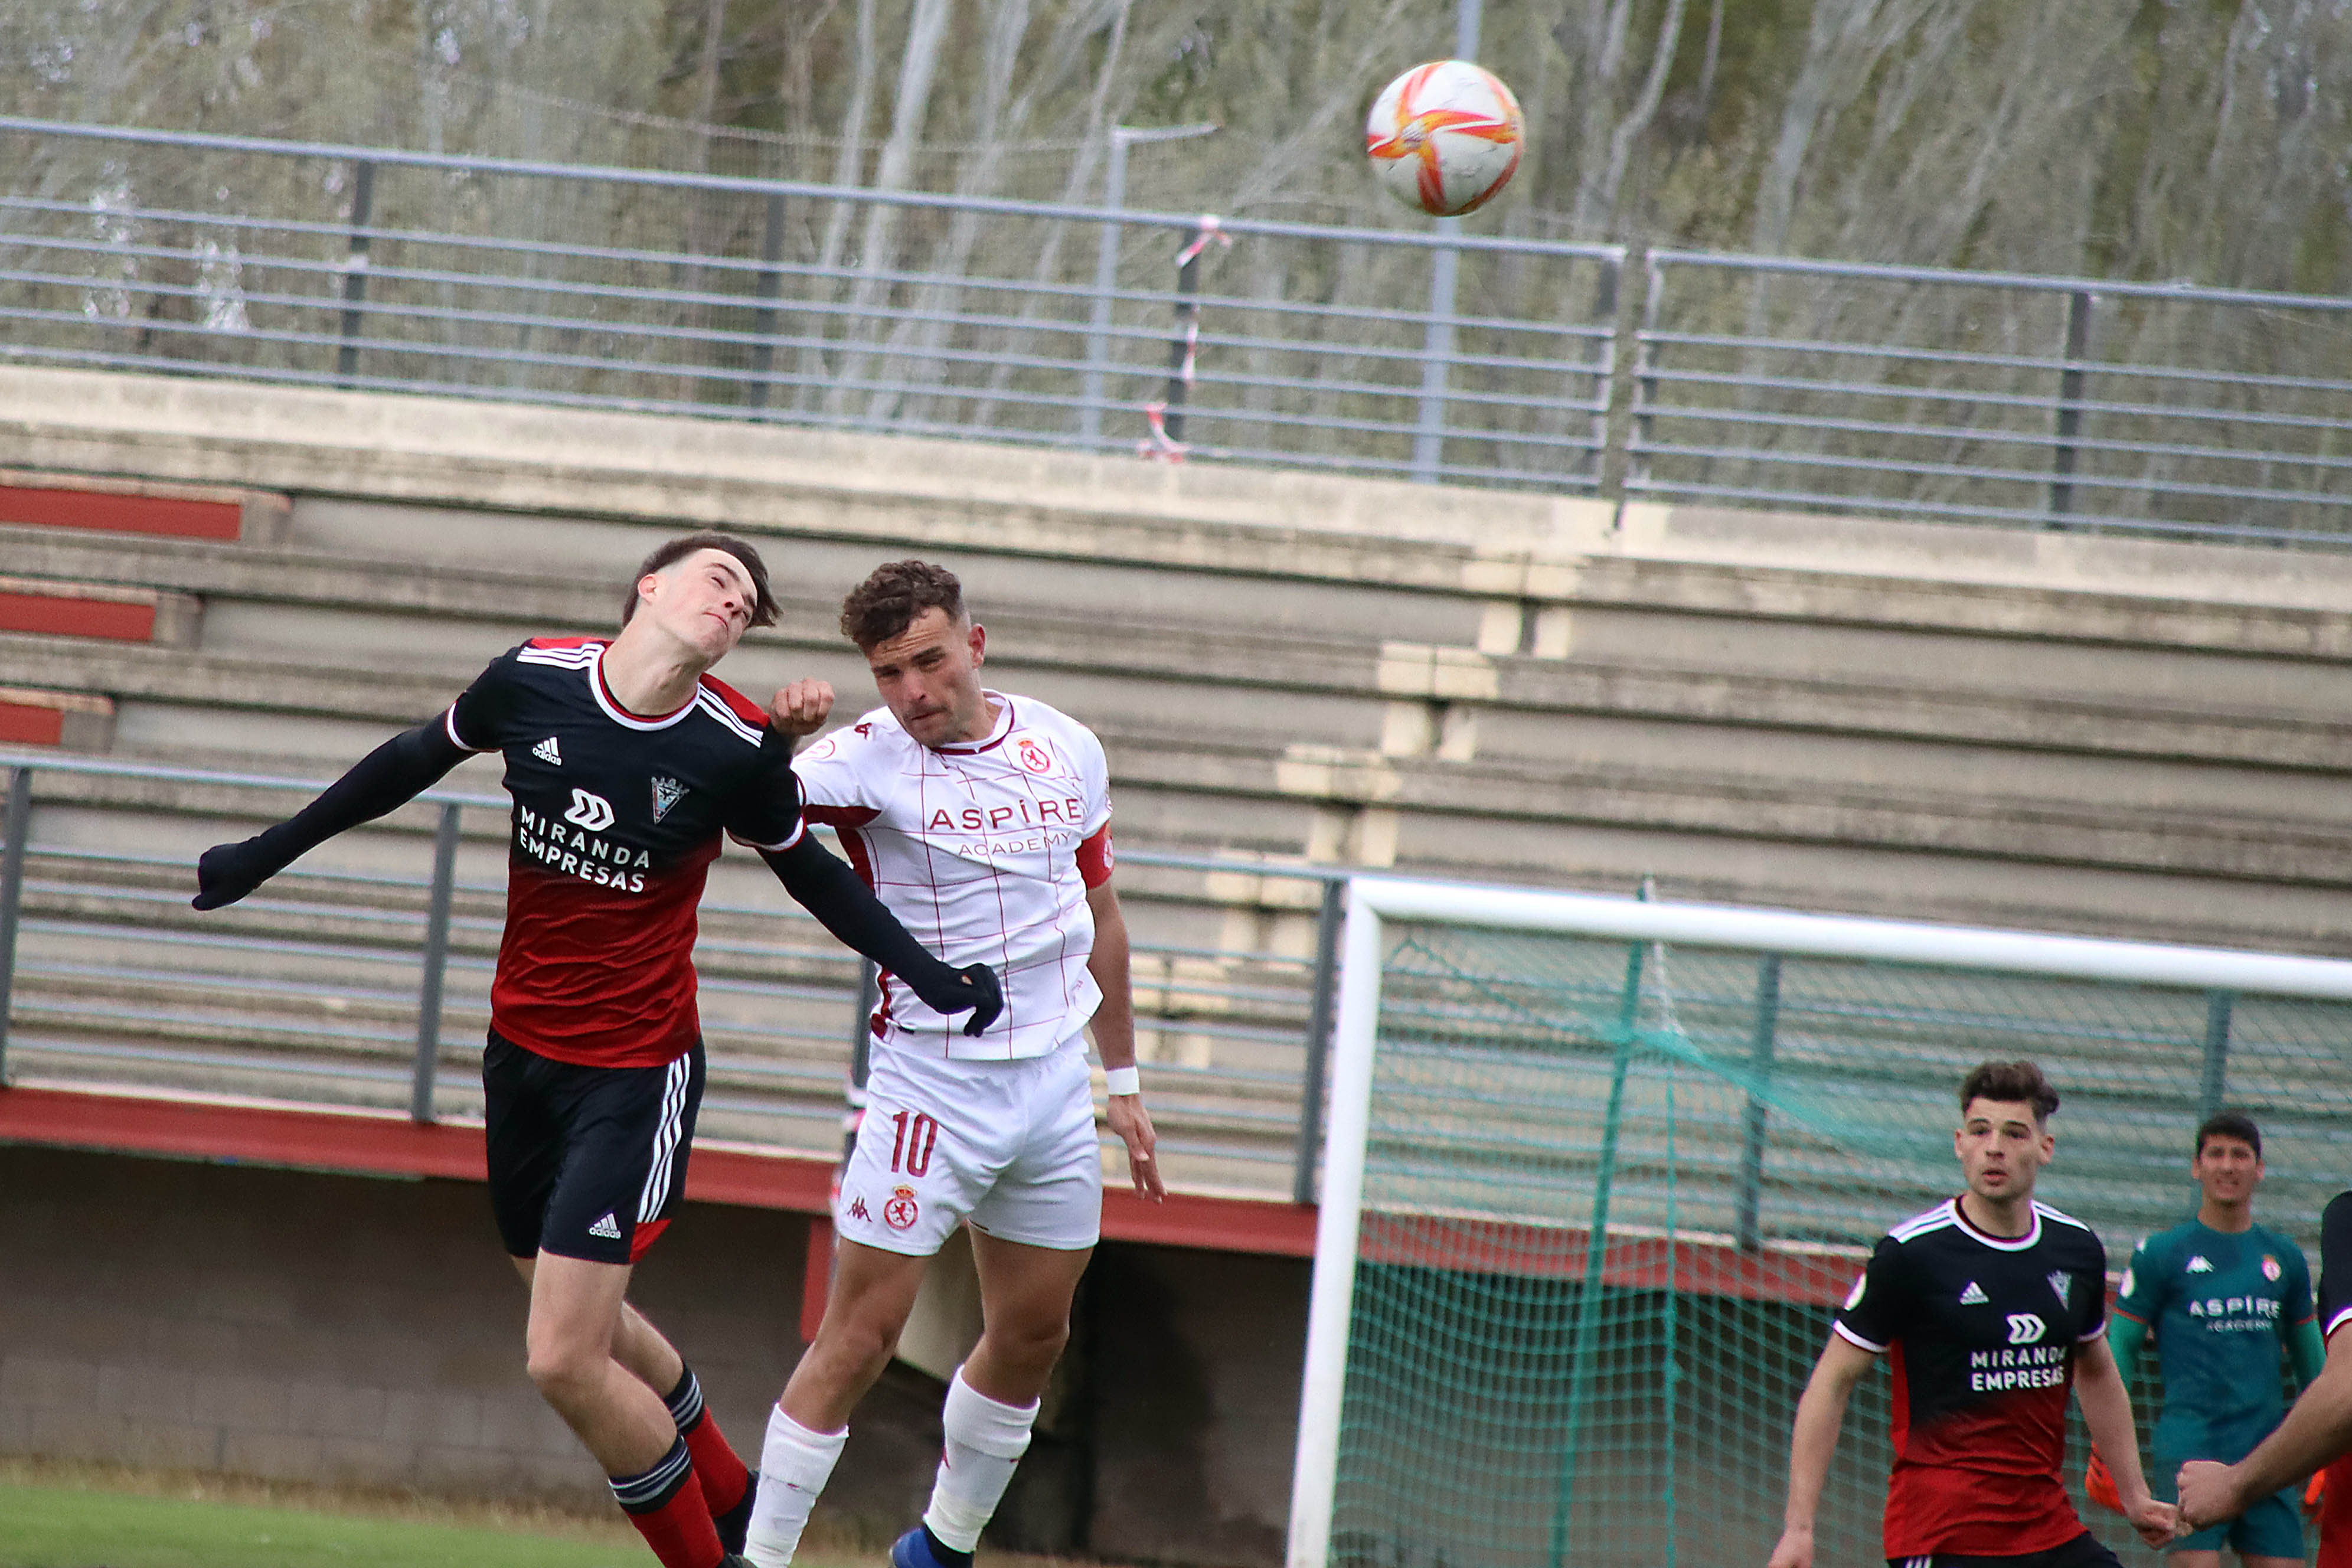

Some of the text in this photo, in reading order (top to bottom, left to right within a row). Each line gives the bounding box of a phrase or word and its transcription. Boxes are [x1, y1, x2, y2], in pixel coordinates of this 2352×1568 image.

[533, 747, 561, 766] adidas
[522, 805, 649, 868] MIRANDA
[959, 831, 1071, 855] ACADEMY
[520, 827, 645, 893] EMPRESAS
[891, 1112, 938, 1177] 10
[589, 1227, 621, 1239] adidas
